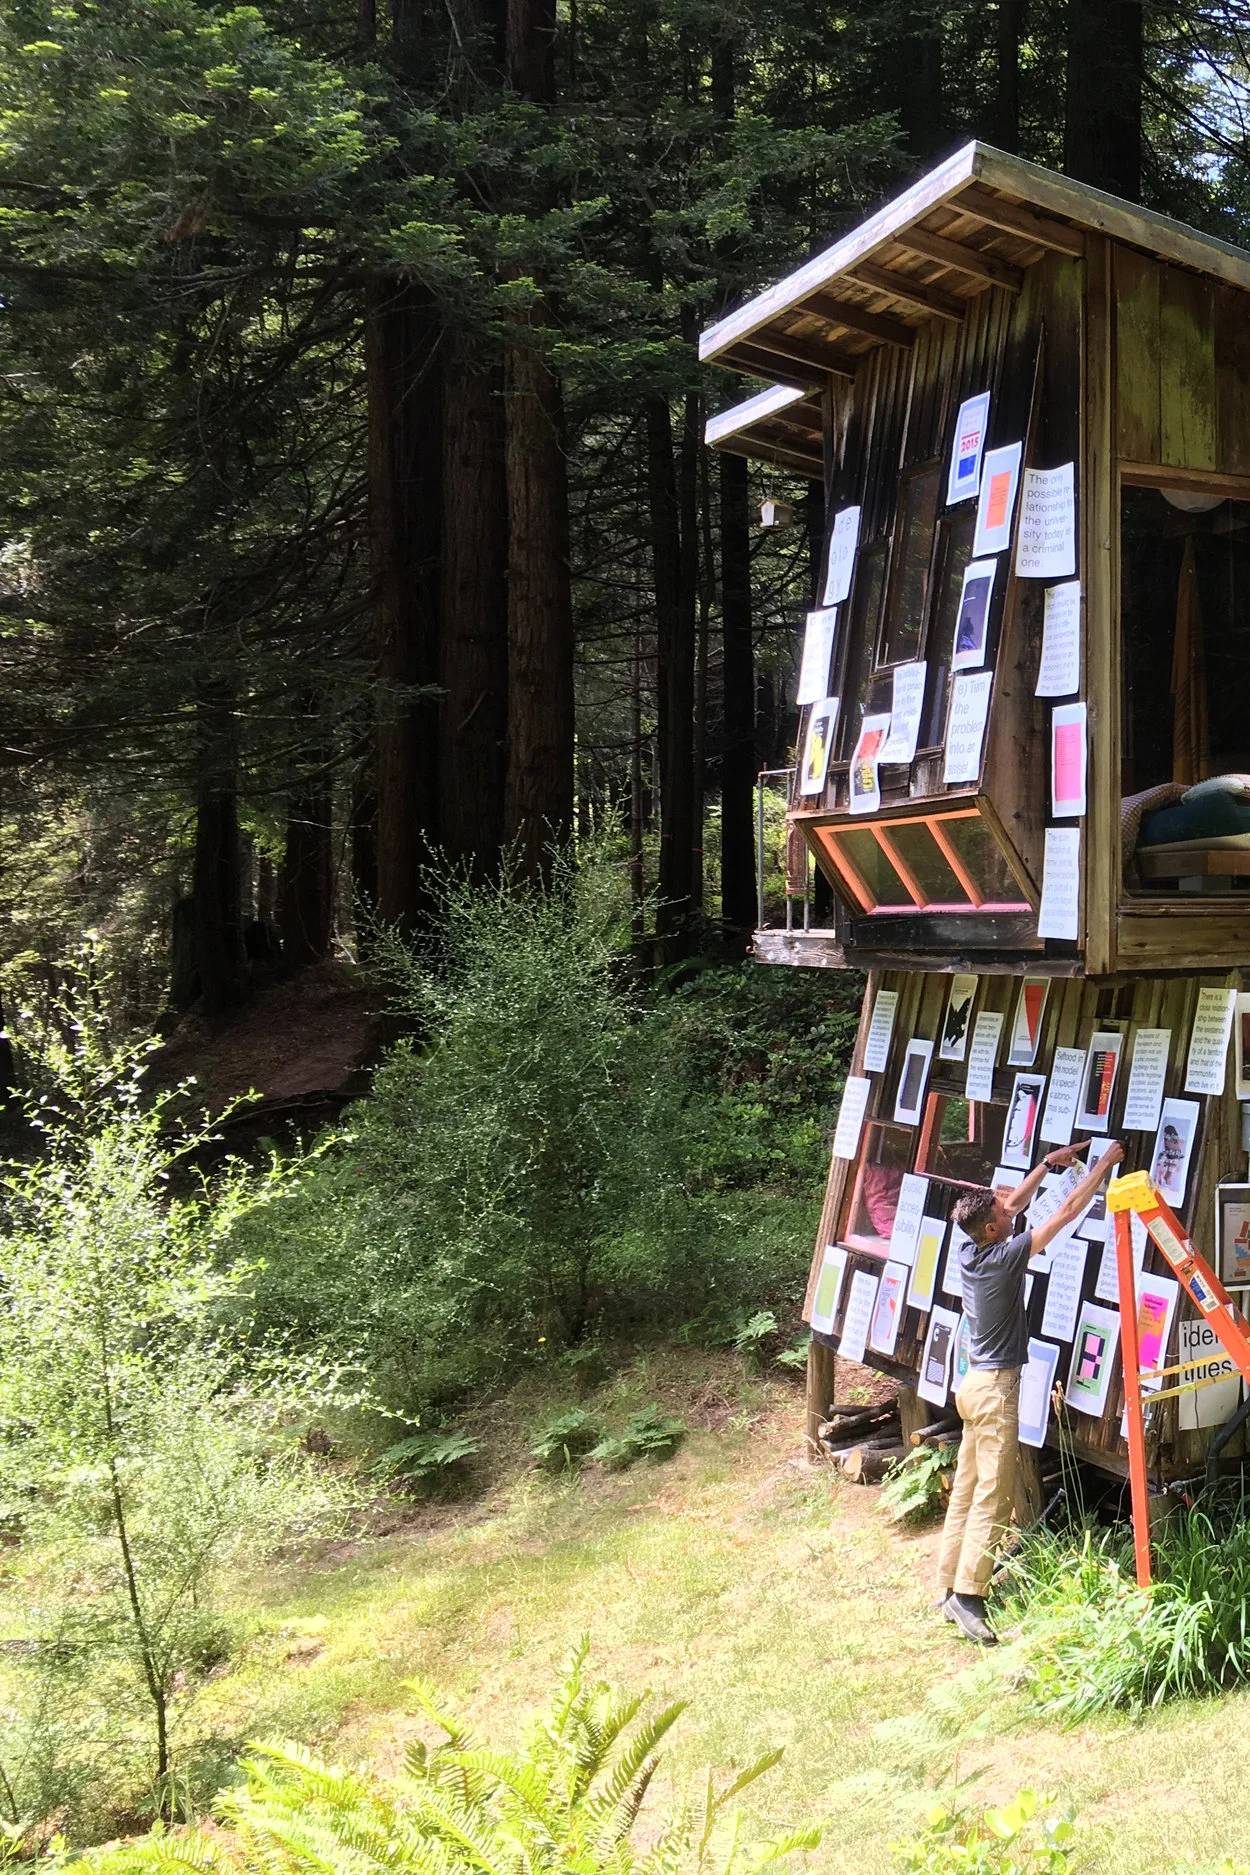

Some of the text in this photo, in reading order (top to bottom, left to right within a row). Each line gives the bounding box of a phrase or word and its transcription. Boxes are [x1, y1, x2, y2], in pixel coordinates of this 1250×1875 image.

[961, 436, 978, 453] 2015
[1029, 473, 1048, 485] The
[1025, 515, 1041, 526] the
[1023, 529, 1064, 541] sity today
[1032, 542, 1064, 553] criminal
[954, 702, 969, 715] the
[949, 742, 965, 755] into
